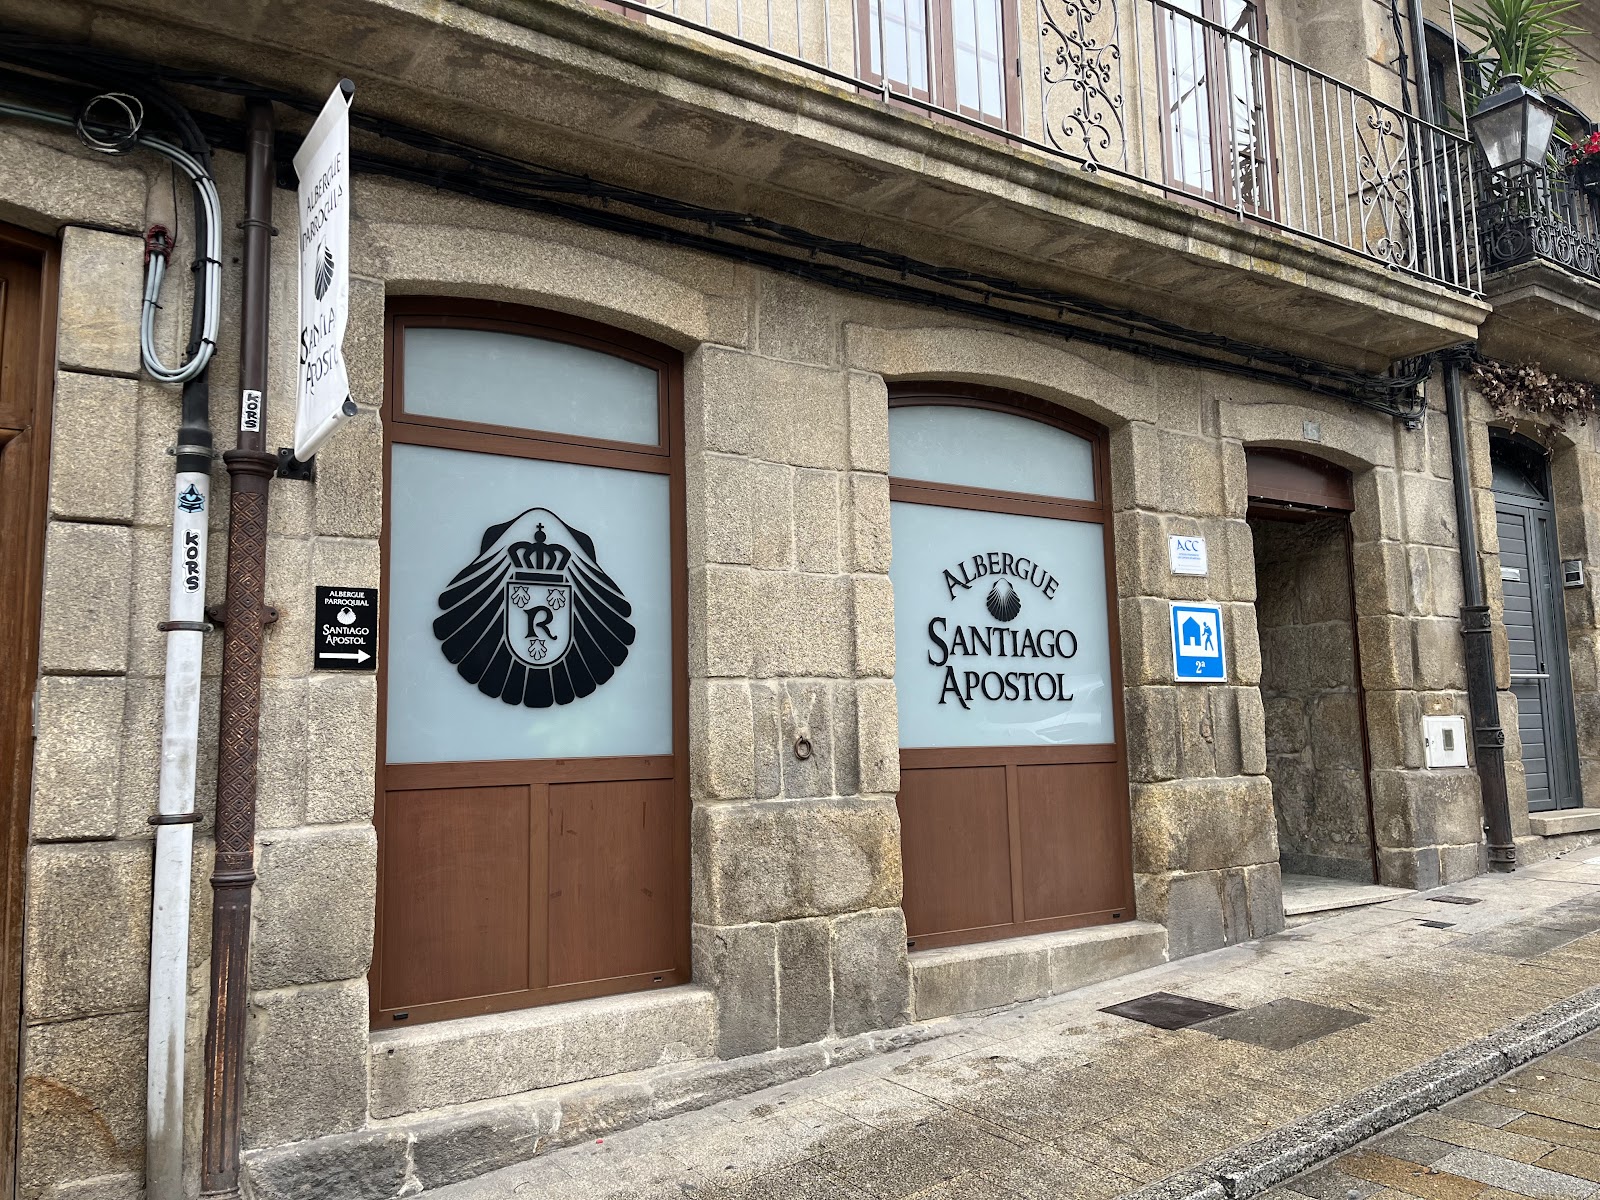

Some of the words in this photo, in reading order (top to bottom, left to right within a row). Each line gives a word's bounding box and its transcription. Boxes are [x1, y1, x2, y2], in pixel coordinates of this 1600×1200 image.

[306, 152, 342, 217] ALBERGUE
[244, 392, 260, 430] KORS
[185, 531, 200, 591] KORS
[1177, 539, 1200, 552] ACC
[942, 552, 1060, 601] ALBERGUE
[324, 598, 370, 607] PARROQUIAL
[329, 591, 365, 599] ALBERGUE
[322, 624, 370, 635] SANTIAGO
[325, 635, 366, 646] APOSTOL
[523, 605, 558, 640] R
[927, 616, 1078, 667] SANTIAGO
[938, 666, 1074, 710] APOSTOL
